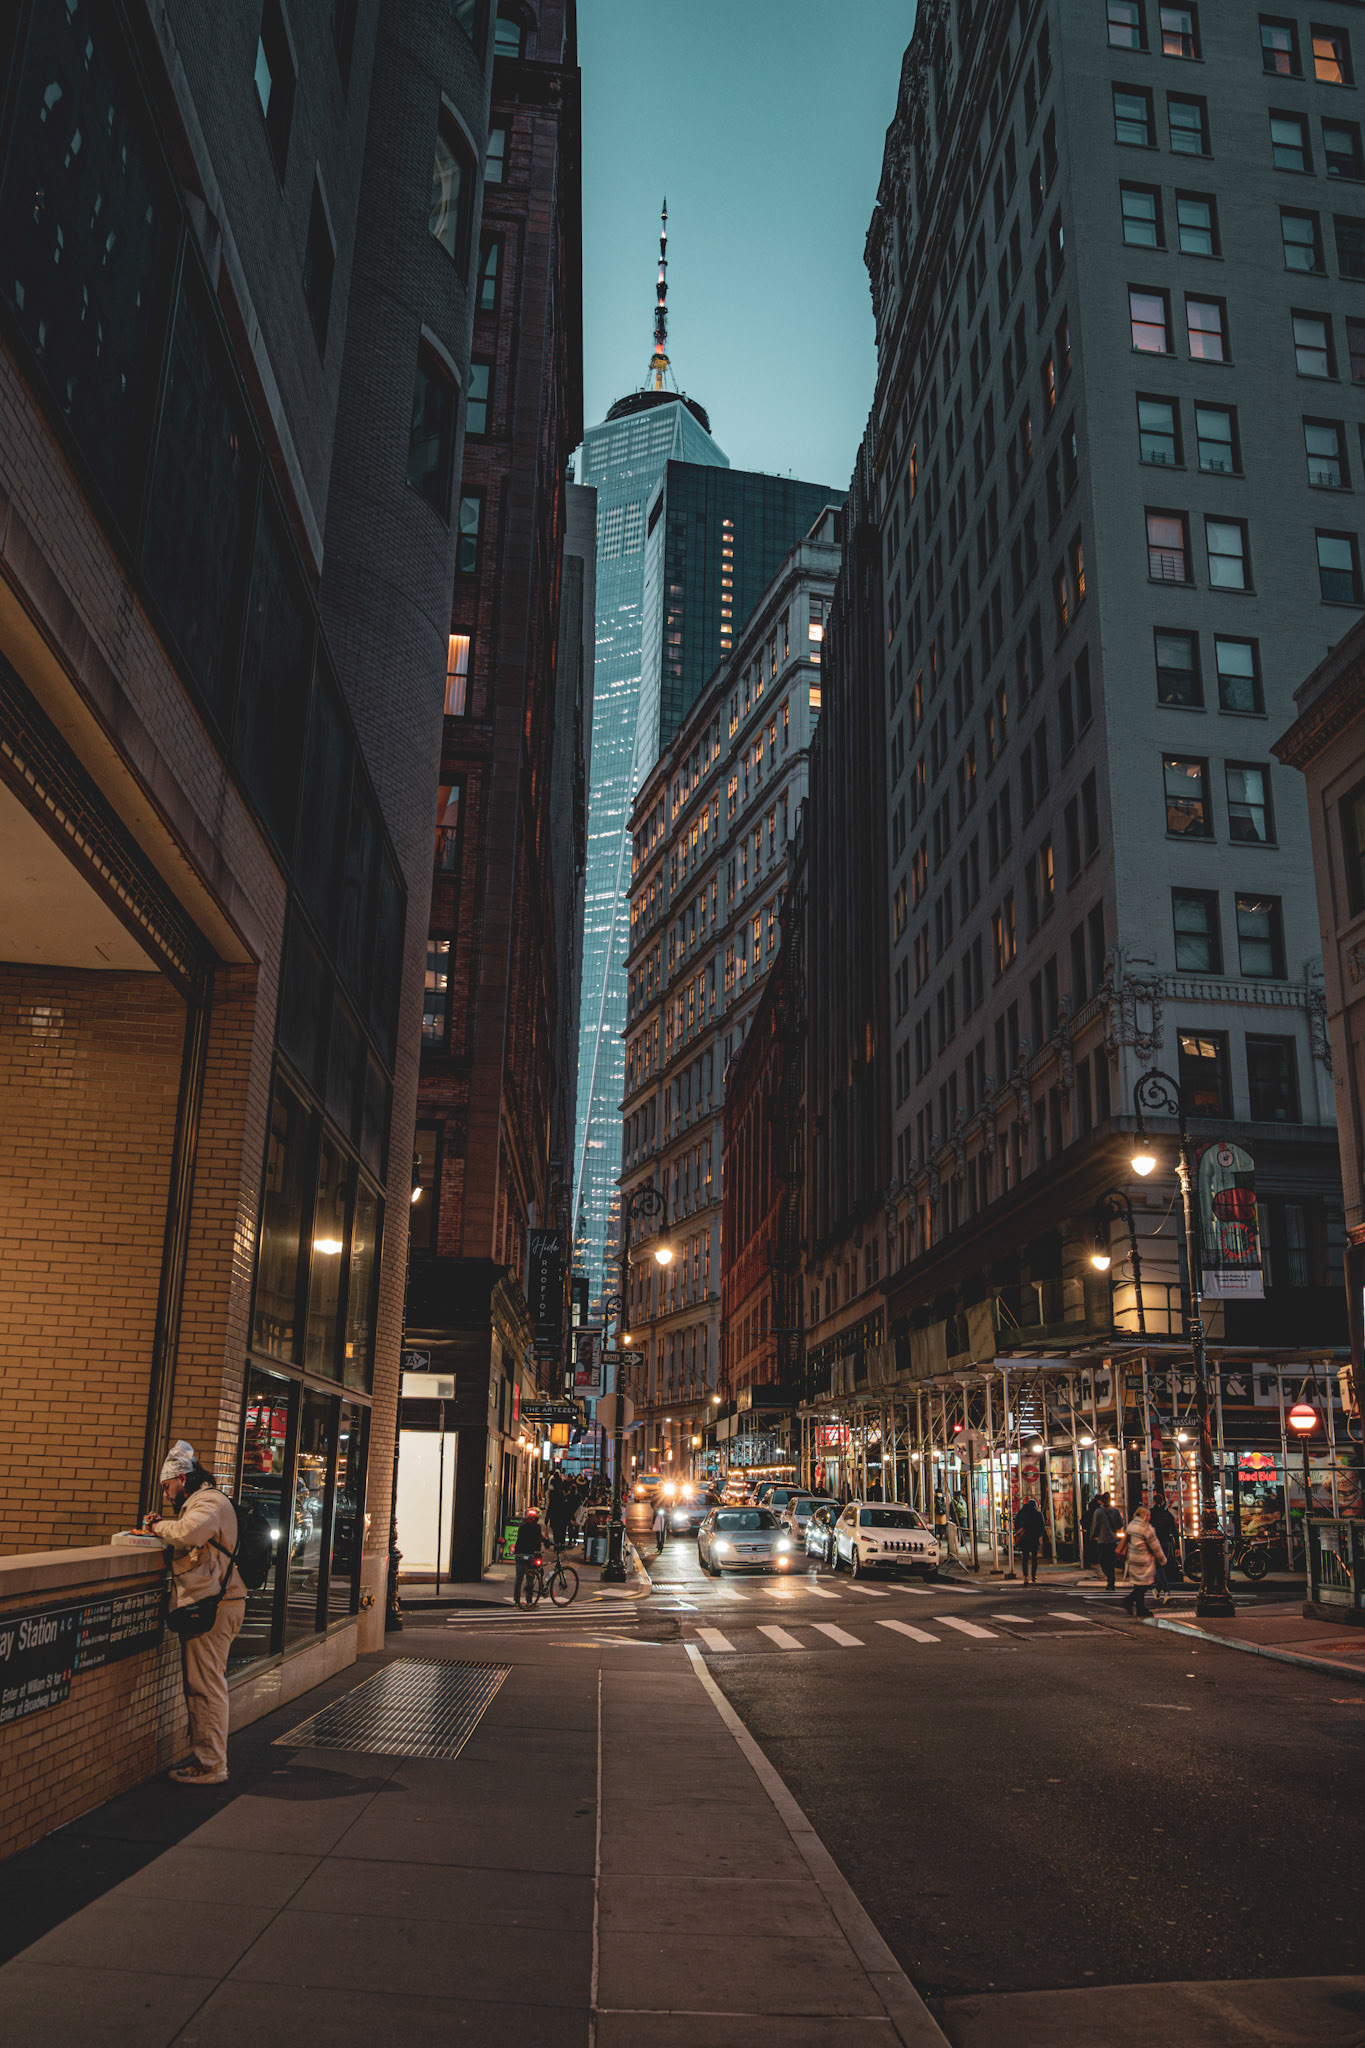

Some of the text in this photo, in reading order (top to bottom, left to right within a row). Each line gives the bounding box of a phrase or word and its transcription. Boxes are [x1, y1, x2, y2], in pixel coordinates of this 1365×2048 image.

[532, 1235, 560, 1259] Hide
[539, 1260, 548, 1319] ROOFTOP
[592, 1368, 600, 1386] STAY
[1226, 1373, 1247, 1396] &
[1172, 1417, 1196, 1426] NASSAU
[1238, 1470, 1277, 1482] Red Bull
[113, 1600, 123, 1614] Enter
[19, 1616, 58, 1651] Station
[60, 1619, 65, 1632] A
[67, 1617, 73, 1631] C
[2, 1687, 19, 1704] Enter
[19, 1682, 26, 1698] at
[0, 1704, 16, 1723] Enter
[16, 1700, 24, 1717] at
[24, 1694, 49, 1713] Broadway
